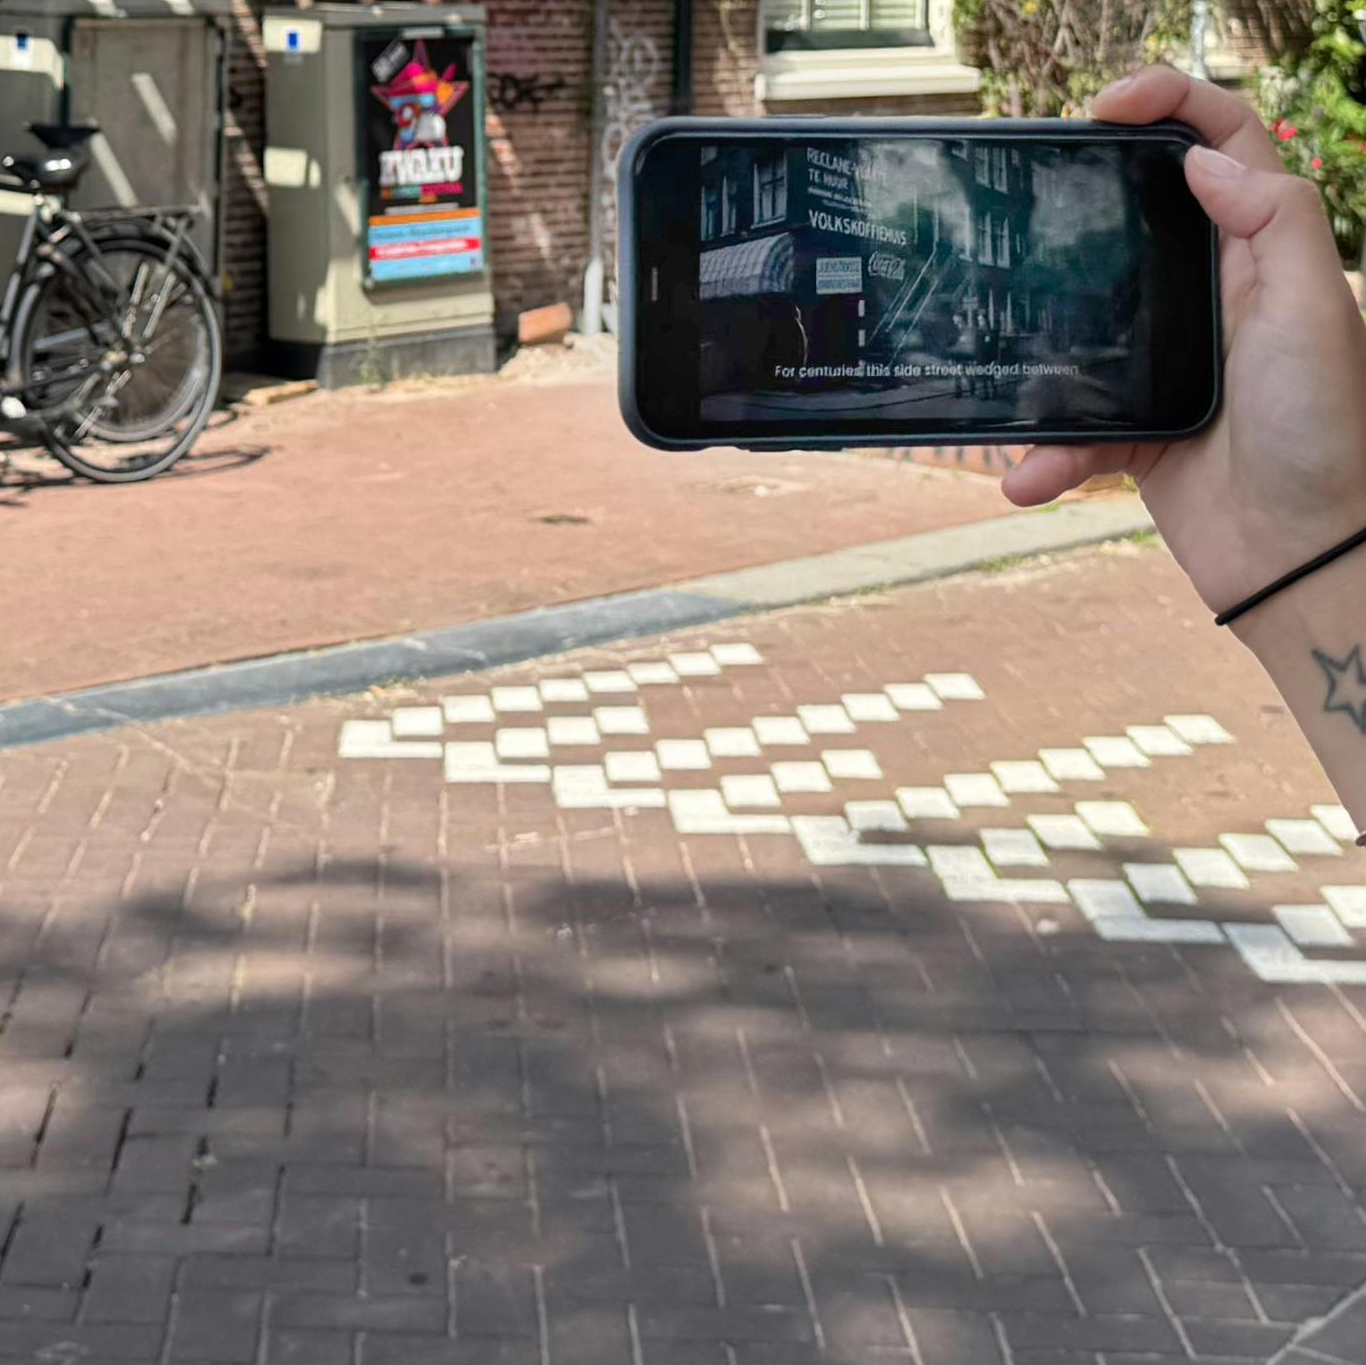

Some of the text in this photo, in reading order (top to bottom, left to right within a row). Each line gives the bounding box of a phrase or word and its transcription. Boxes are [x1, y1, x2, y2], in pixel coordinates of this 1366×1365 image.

[808, 208, 907, 246] VOLKSKOFFIEHUIS
[774, 361, 1080, 380] For centuries this side street wedged between
